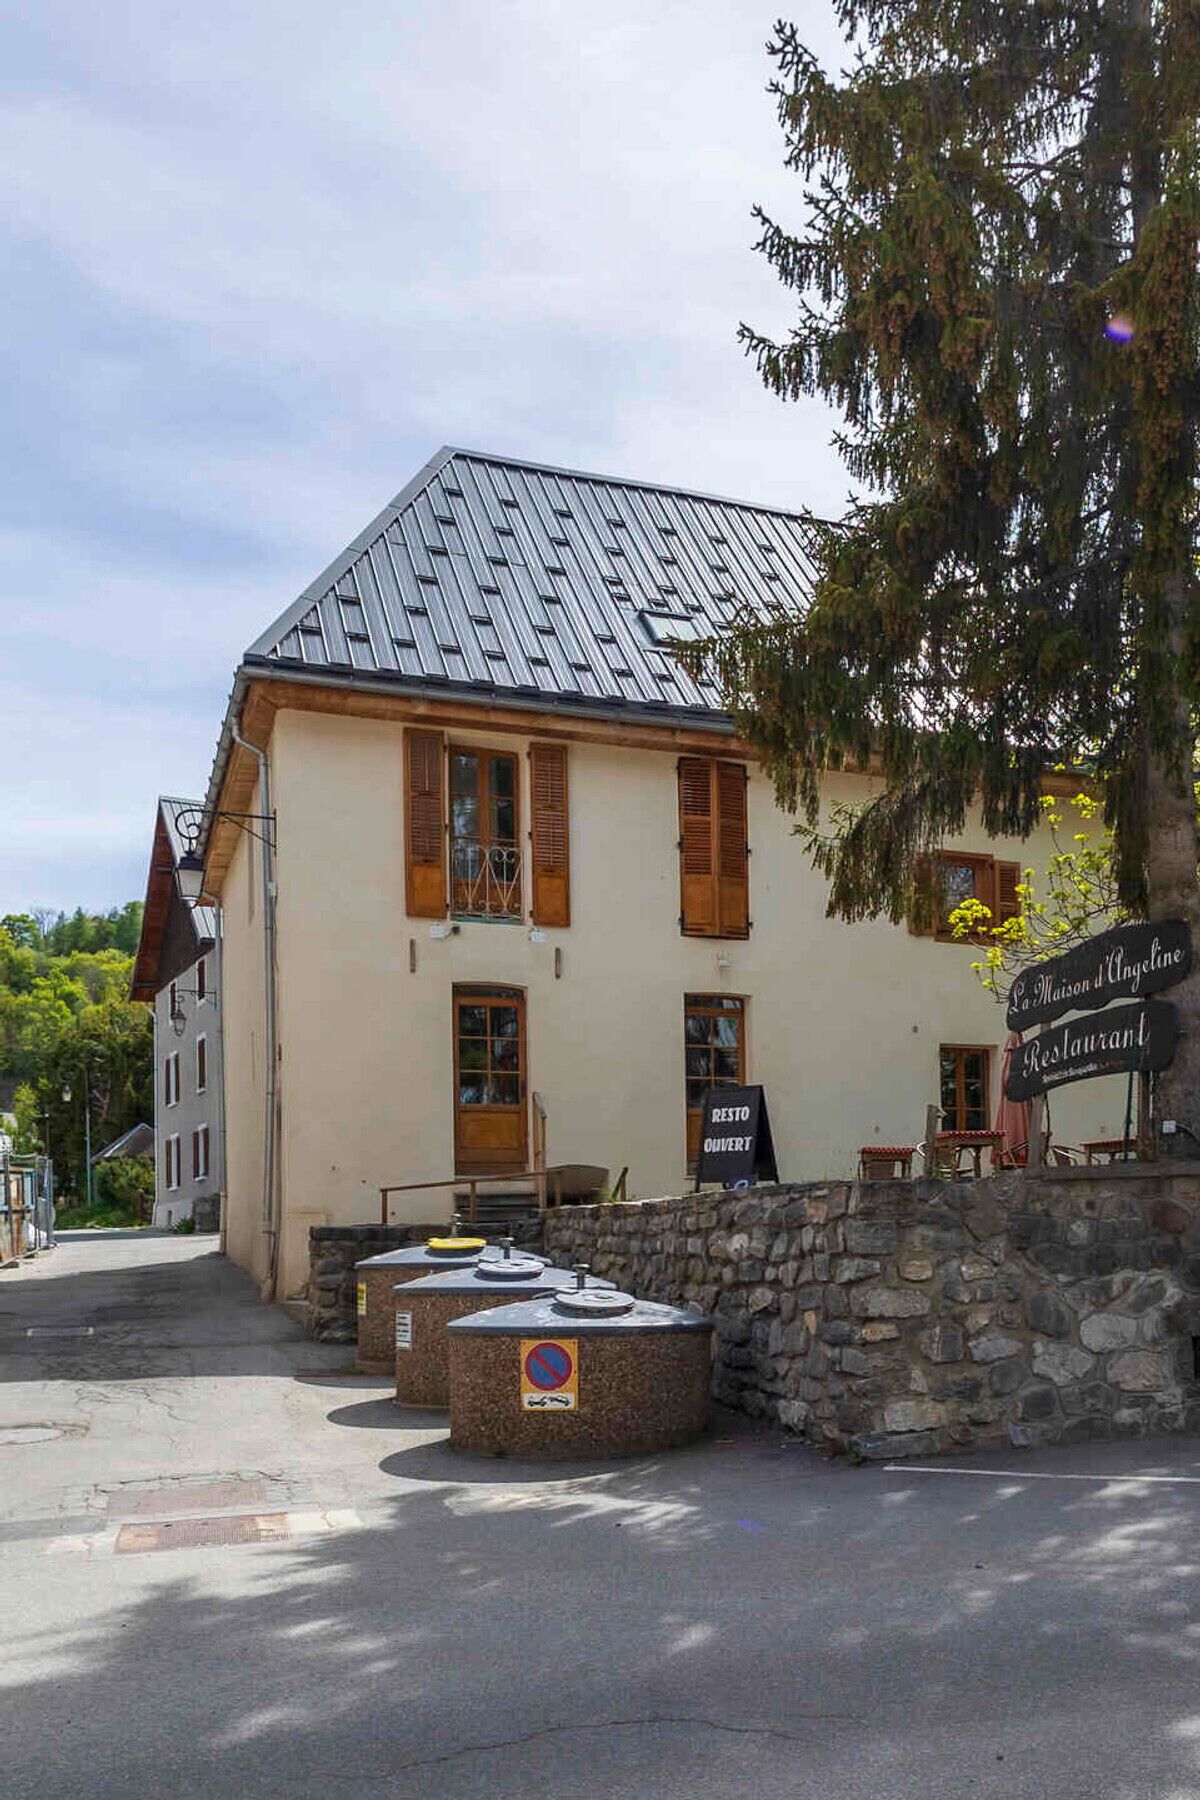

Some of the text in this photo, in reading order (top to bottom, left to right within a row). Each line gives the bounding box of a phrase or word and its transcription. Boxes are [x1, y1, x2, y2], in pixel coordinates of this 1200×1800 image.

[1008, 936, 1186, 1015] La Maison d'Angeline
[1022, 1011, 1151, 1079] Restaurant
[711, 1106, 750, 1123] RESTO
[703, 1136, 753, 1153] OUVERT
